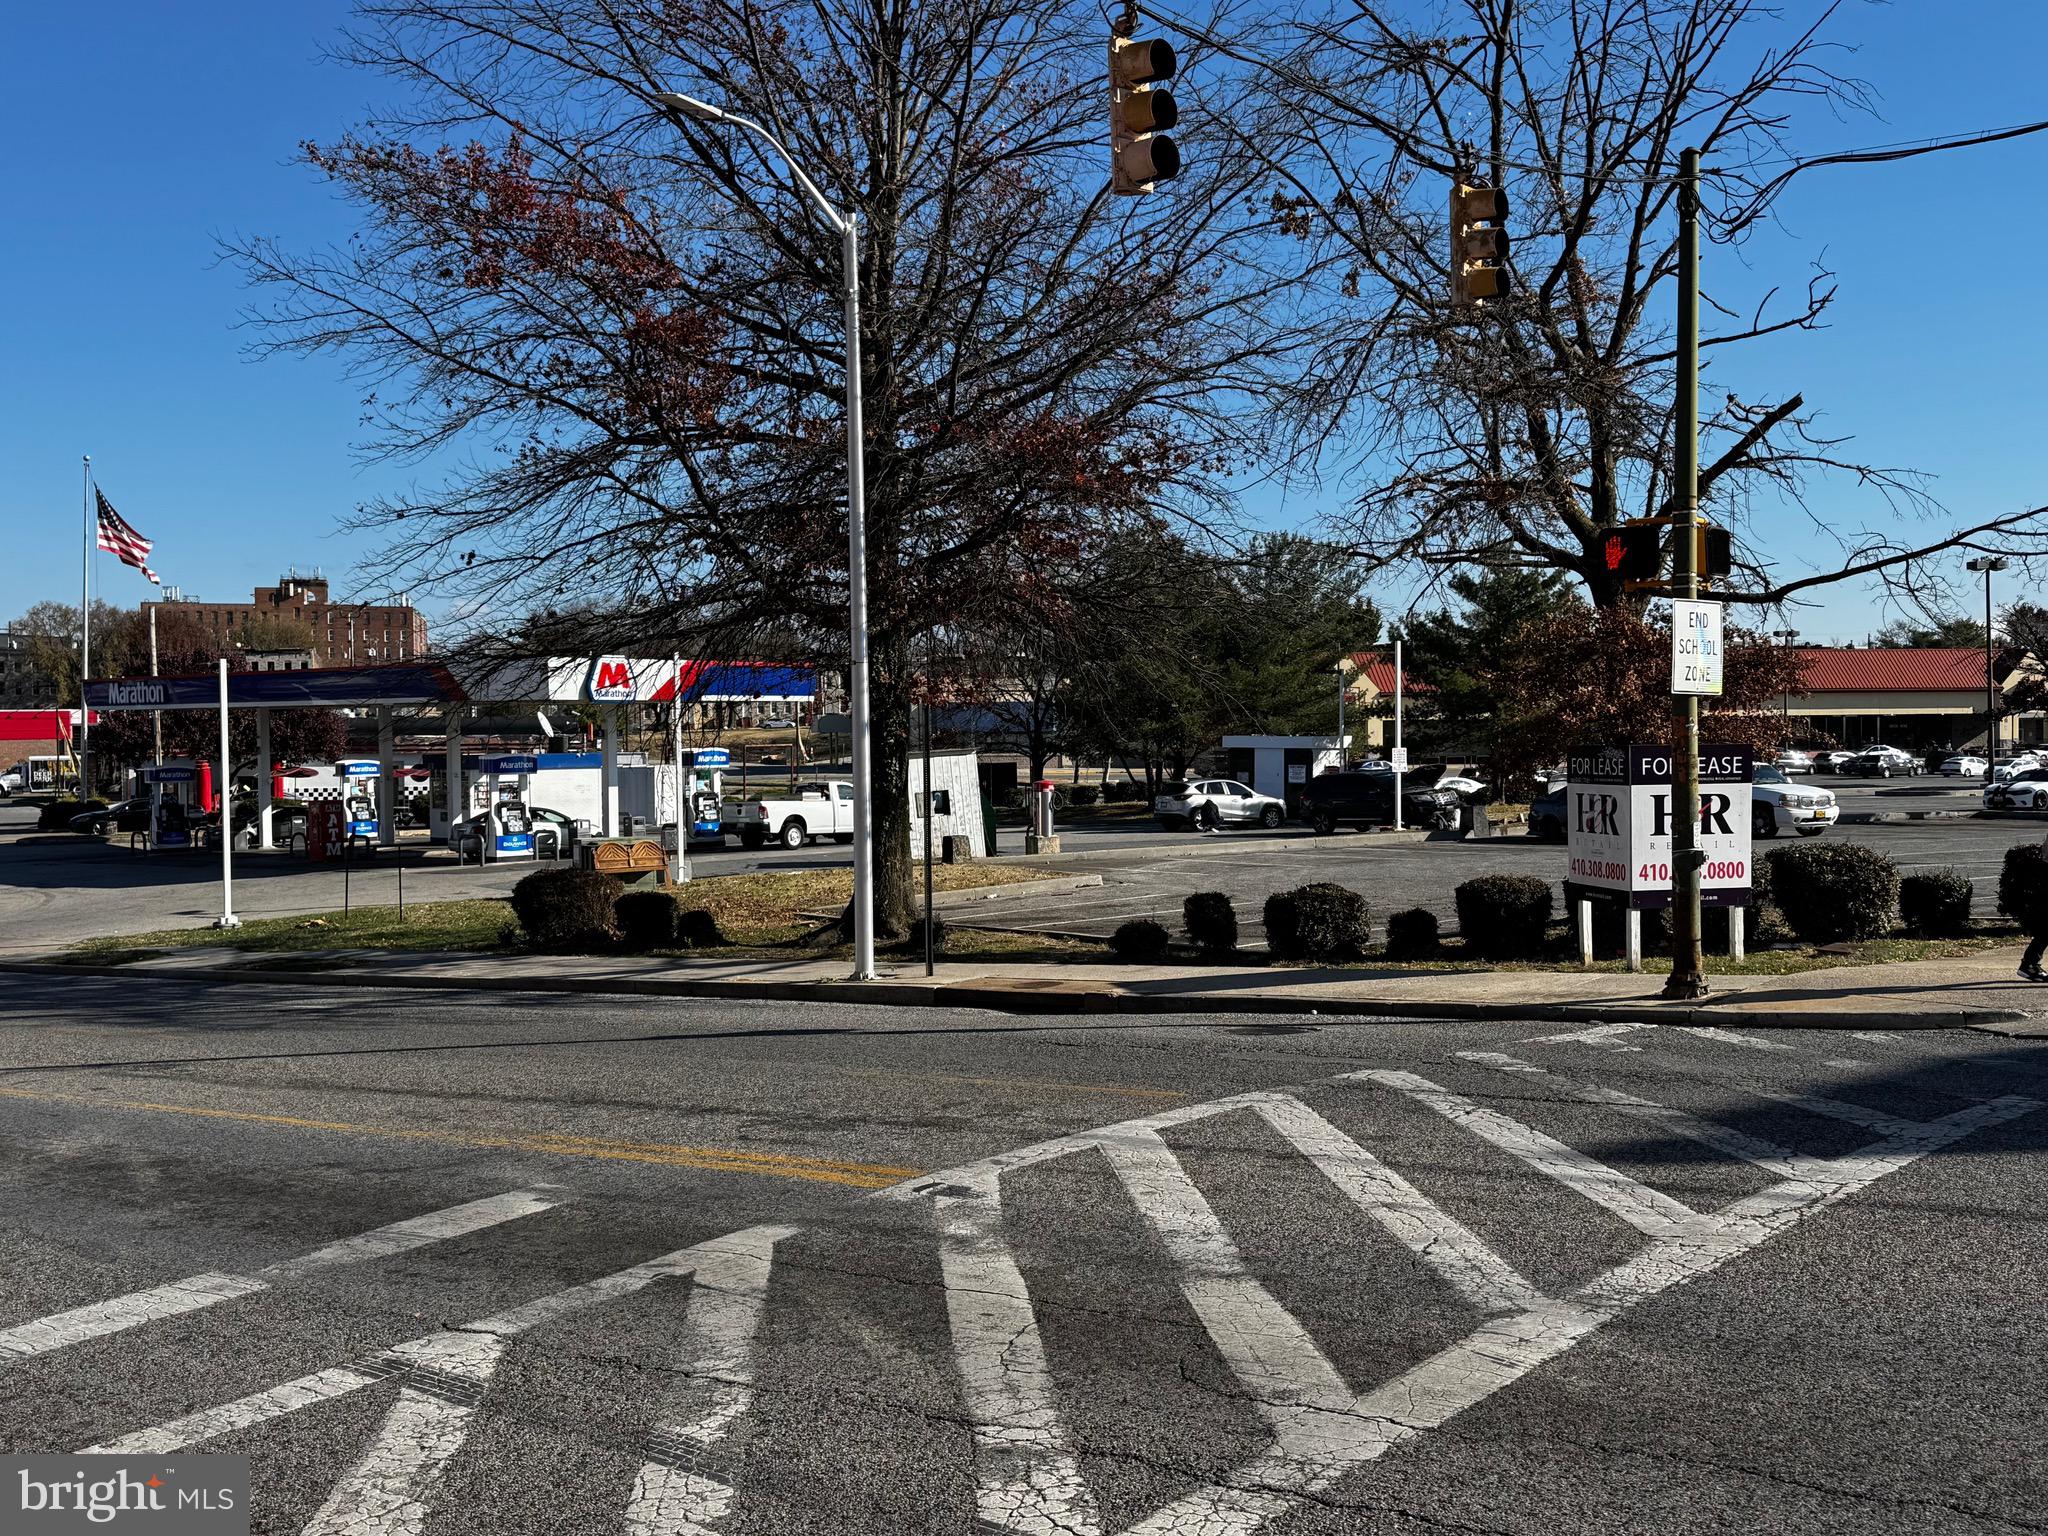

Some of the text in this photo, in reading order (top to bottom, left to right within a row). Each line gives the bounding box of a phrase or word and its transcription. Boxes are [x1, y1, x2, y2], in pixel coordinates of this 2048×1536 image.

[1689, 612, 1708, 628] END
[1679, 639, 1717, 655] SCHOOL
[596, 662, 630, 688] M
[1685, 666, 1711, 682] ZONE
[108, 682, 164, 704] Marathon
[1571, 758, 1624, 775] FOR LEASE
[1642, 756, 1743, 775] FO EASE
[326, 814, 341, 856] ATM
[1571, 858, 1627, 881] 410.308.0800
[1639, 862, 1745, 881] 410..0800
